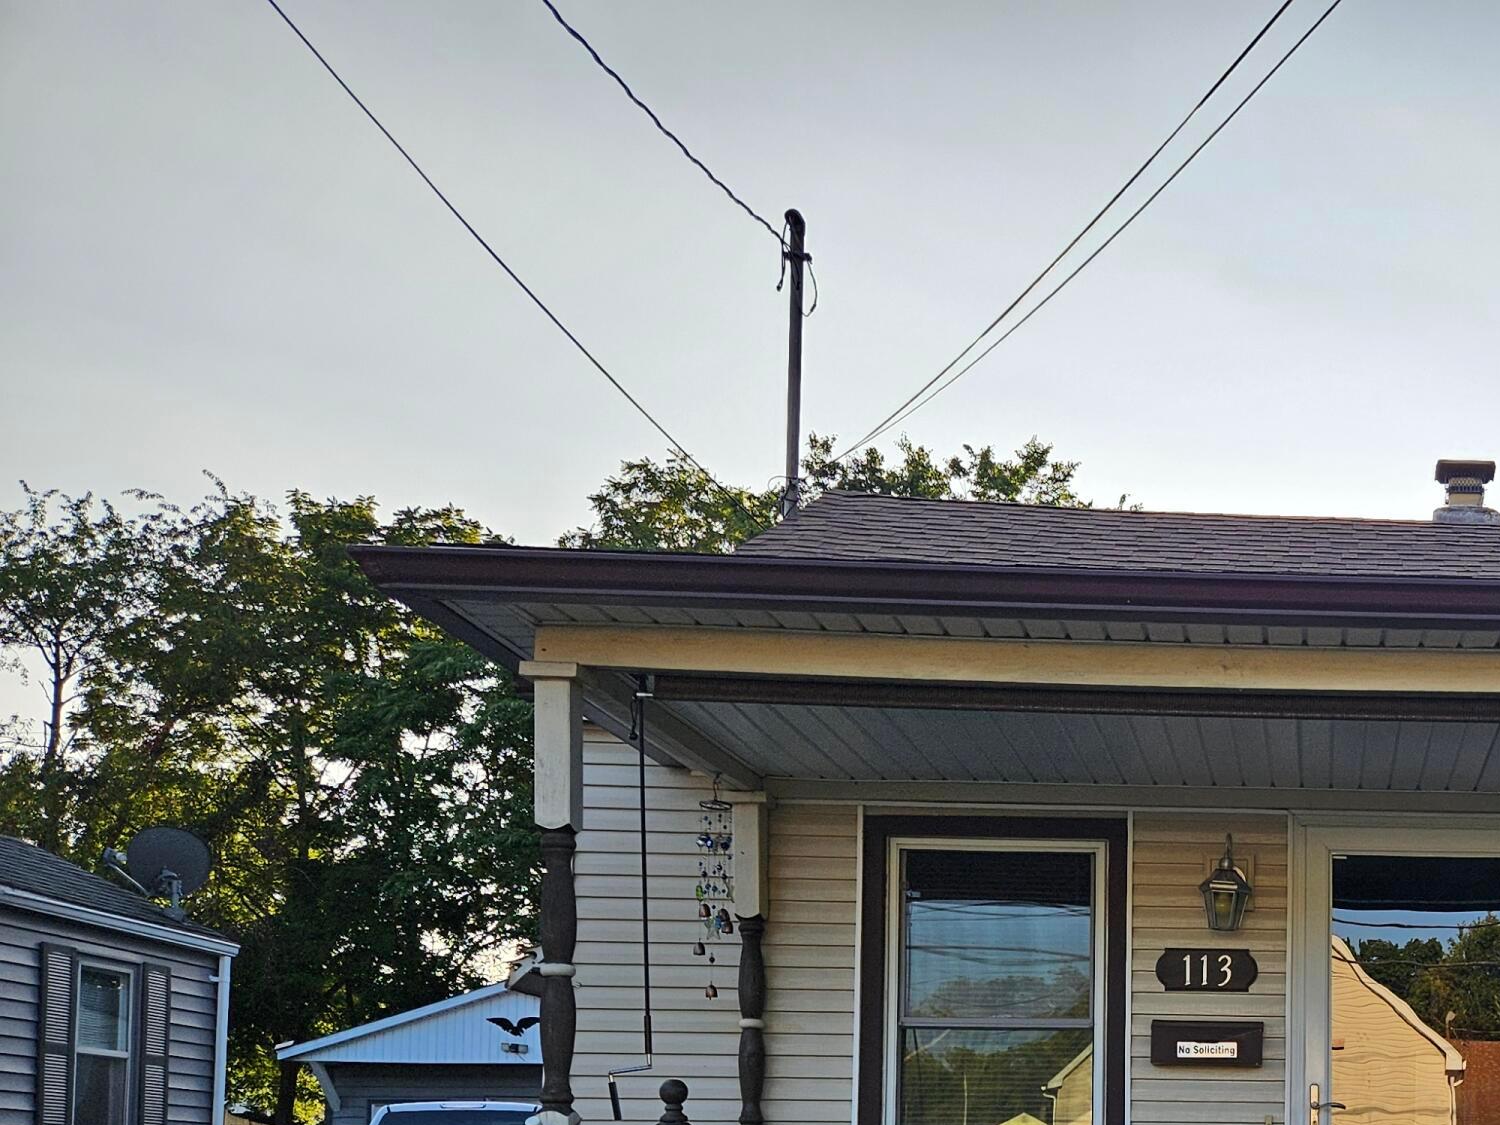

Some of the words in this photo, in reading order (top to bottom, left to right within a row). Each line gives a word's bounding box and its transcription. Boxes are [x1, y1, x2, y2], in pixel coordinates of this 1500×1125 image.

[1182, 954, 1233, 987] 113
[1178, 1045, 1191, 1054] No
[1193, 1045, 1235, 1057] Soliciting
